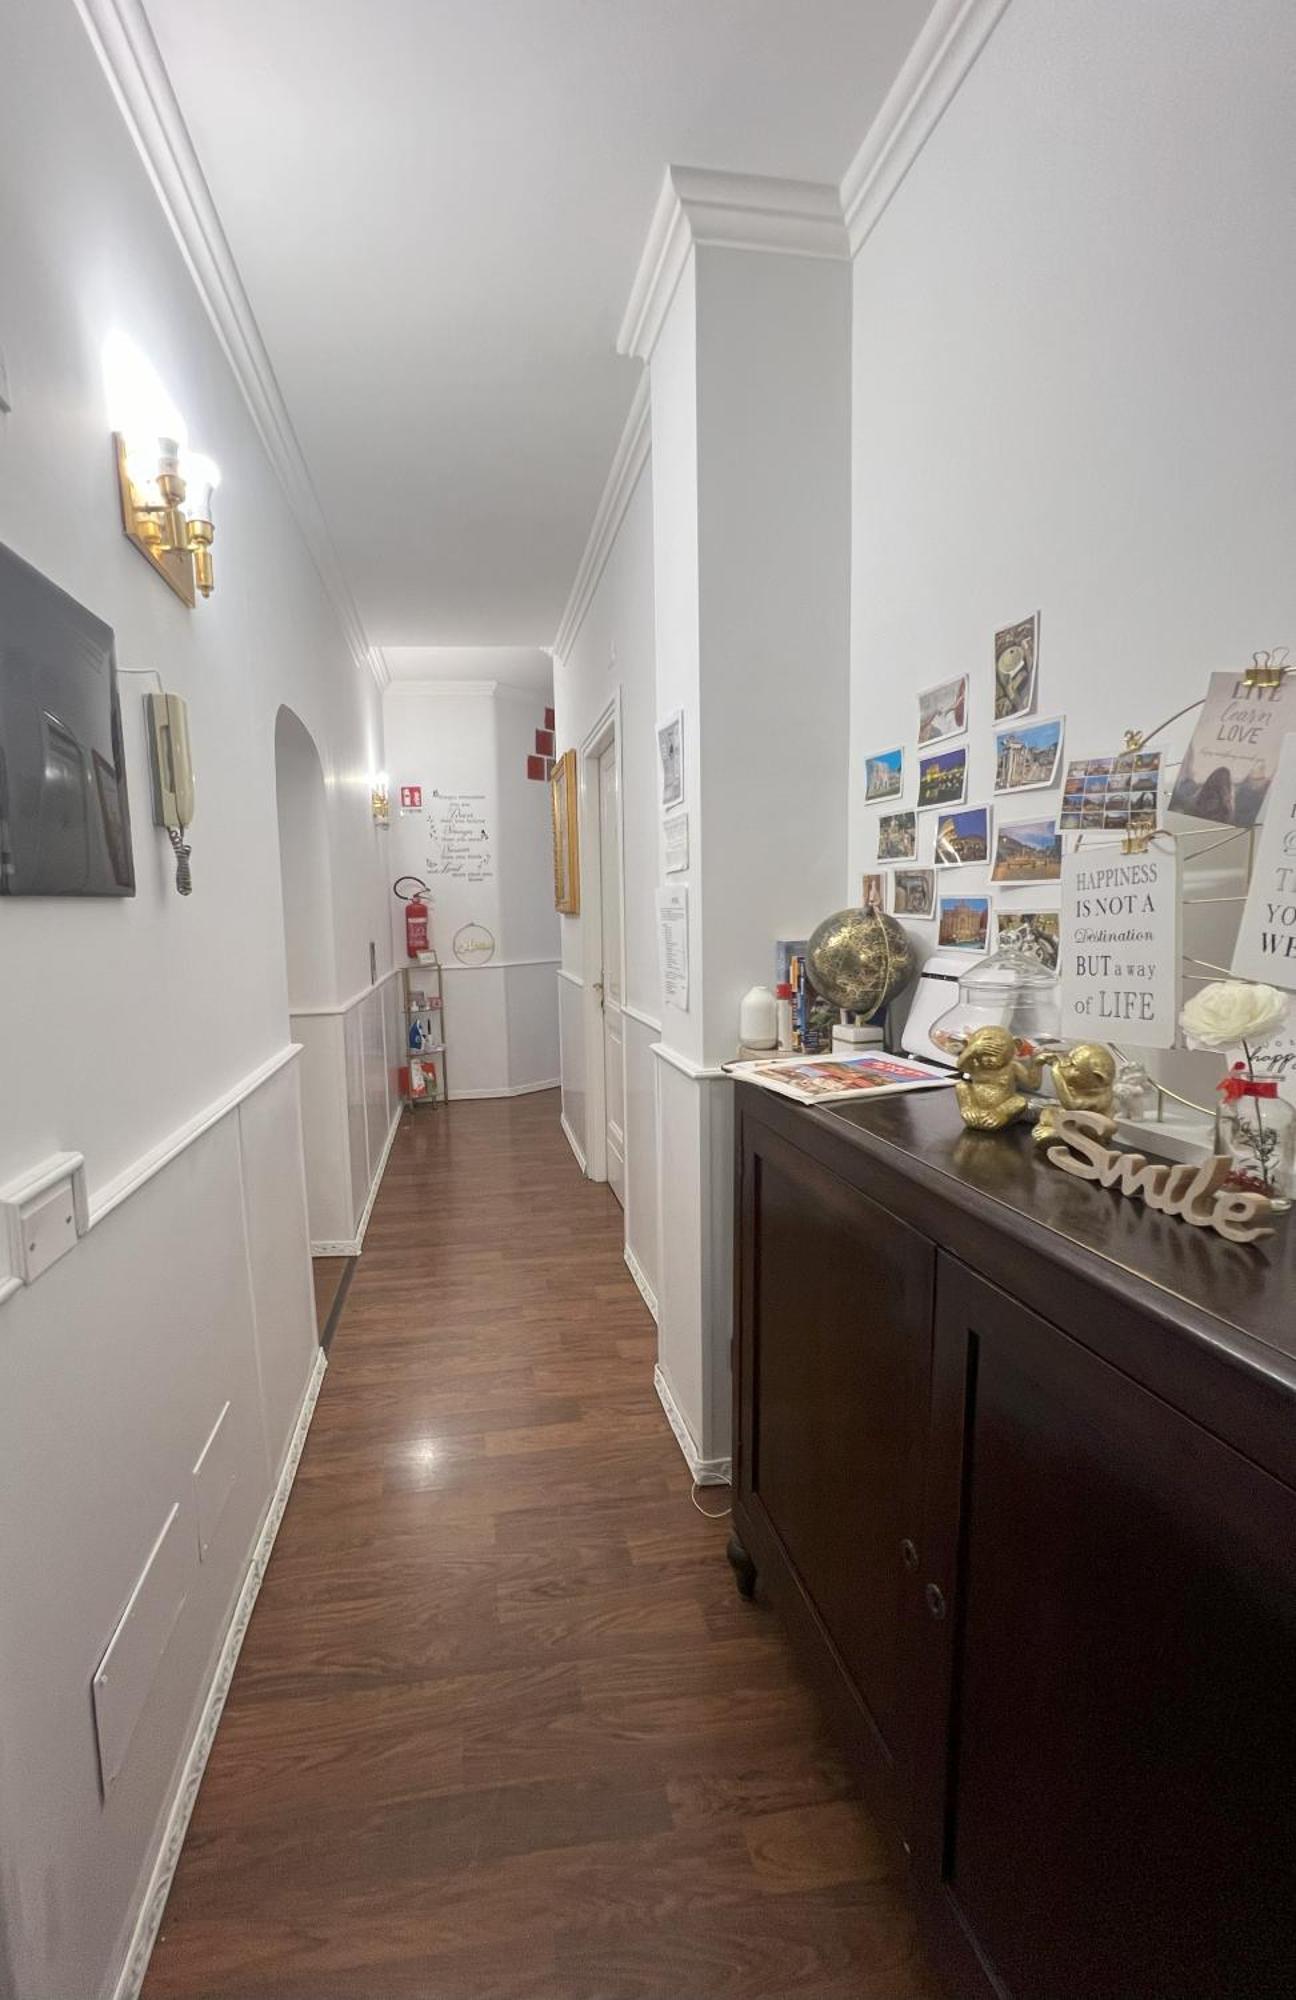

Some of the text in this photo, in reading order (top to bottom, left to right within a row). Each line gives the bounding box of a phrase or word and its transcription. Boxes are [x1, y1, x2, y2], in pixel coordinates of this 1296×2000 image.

[1216, 725, 1264, 745] LOVE
[1076, 863, 1158, 892] HAPPINESS
[1076, 892, 1155, 918] IS NOT A
[1074, 927, 1153, 944] Destination
[1076, 955, 1156, 981] BUT a way
[1074, 990, 1155, 1021] of LIFE
